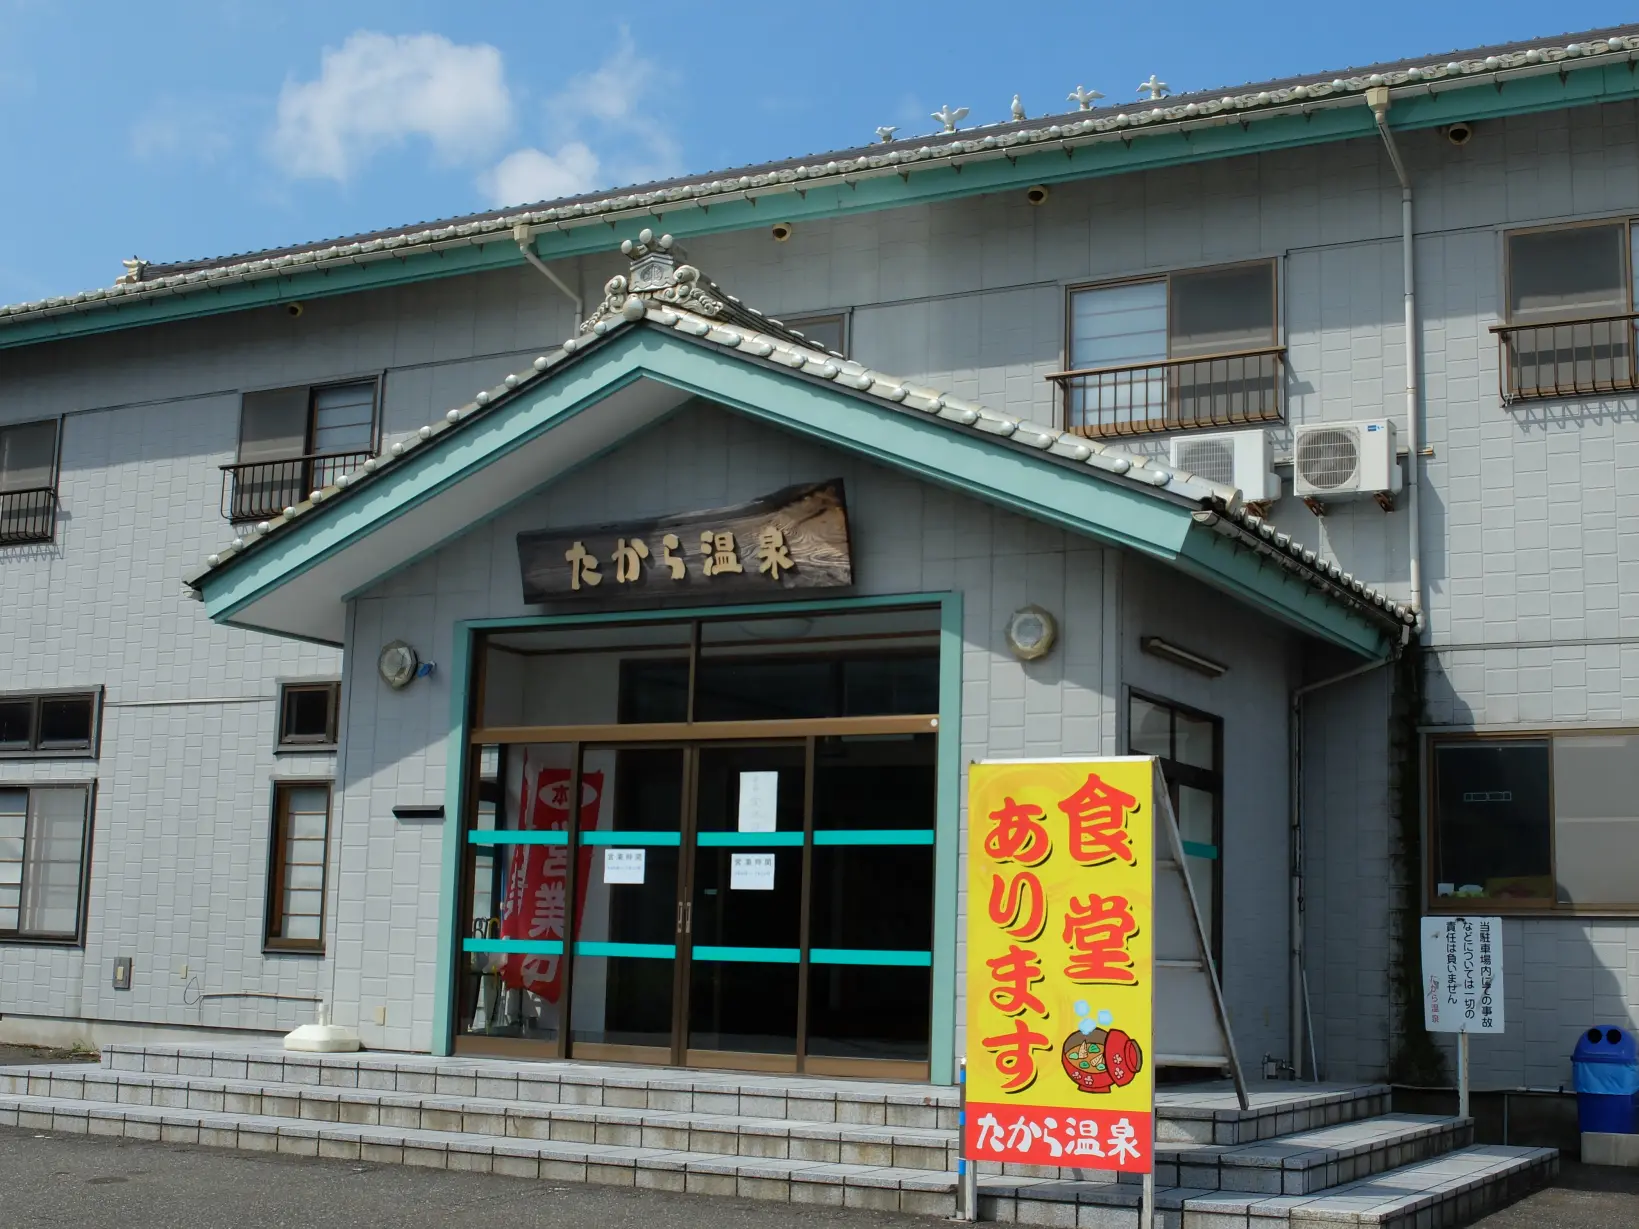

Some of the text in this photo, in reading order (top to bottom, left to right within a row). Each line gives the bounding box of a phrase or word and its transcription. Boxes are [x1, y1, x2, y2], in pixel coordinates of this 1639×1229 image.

[565, 526, 795, 591] たから温泉
[1057, 772, 1140, 985] 食堂
[983, 796, 1053, 1094] あります
[1446, 921, 1458, 1004] 責任は負いません
[1463, 921, 1475, 1019] などについては一切の
[1479, 921, 1493, 1028] 当駐車場内にての事故
[1430, 975, 1440, 1023] たから温泉
[976, 1112, 1141, 1165] たから温泉
